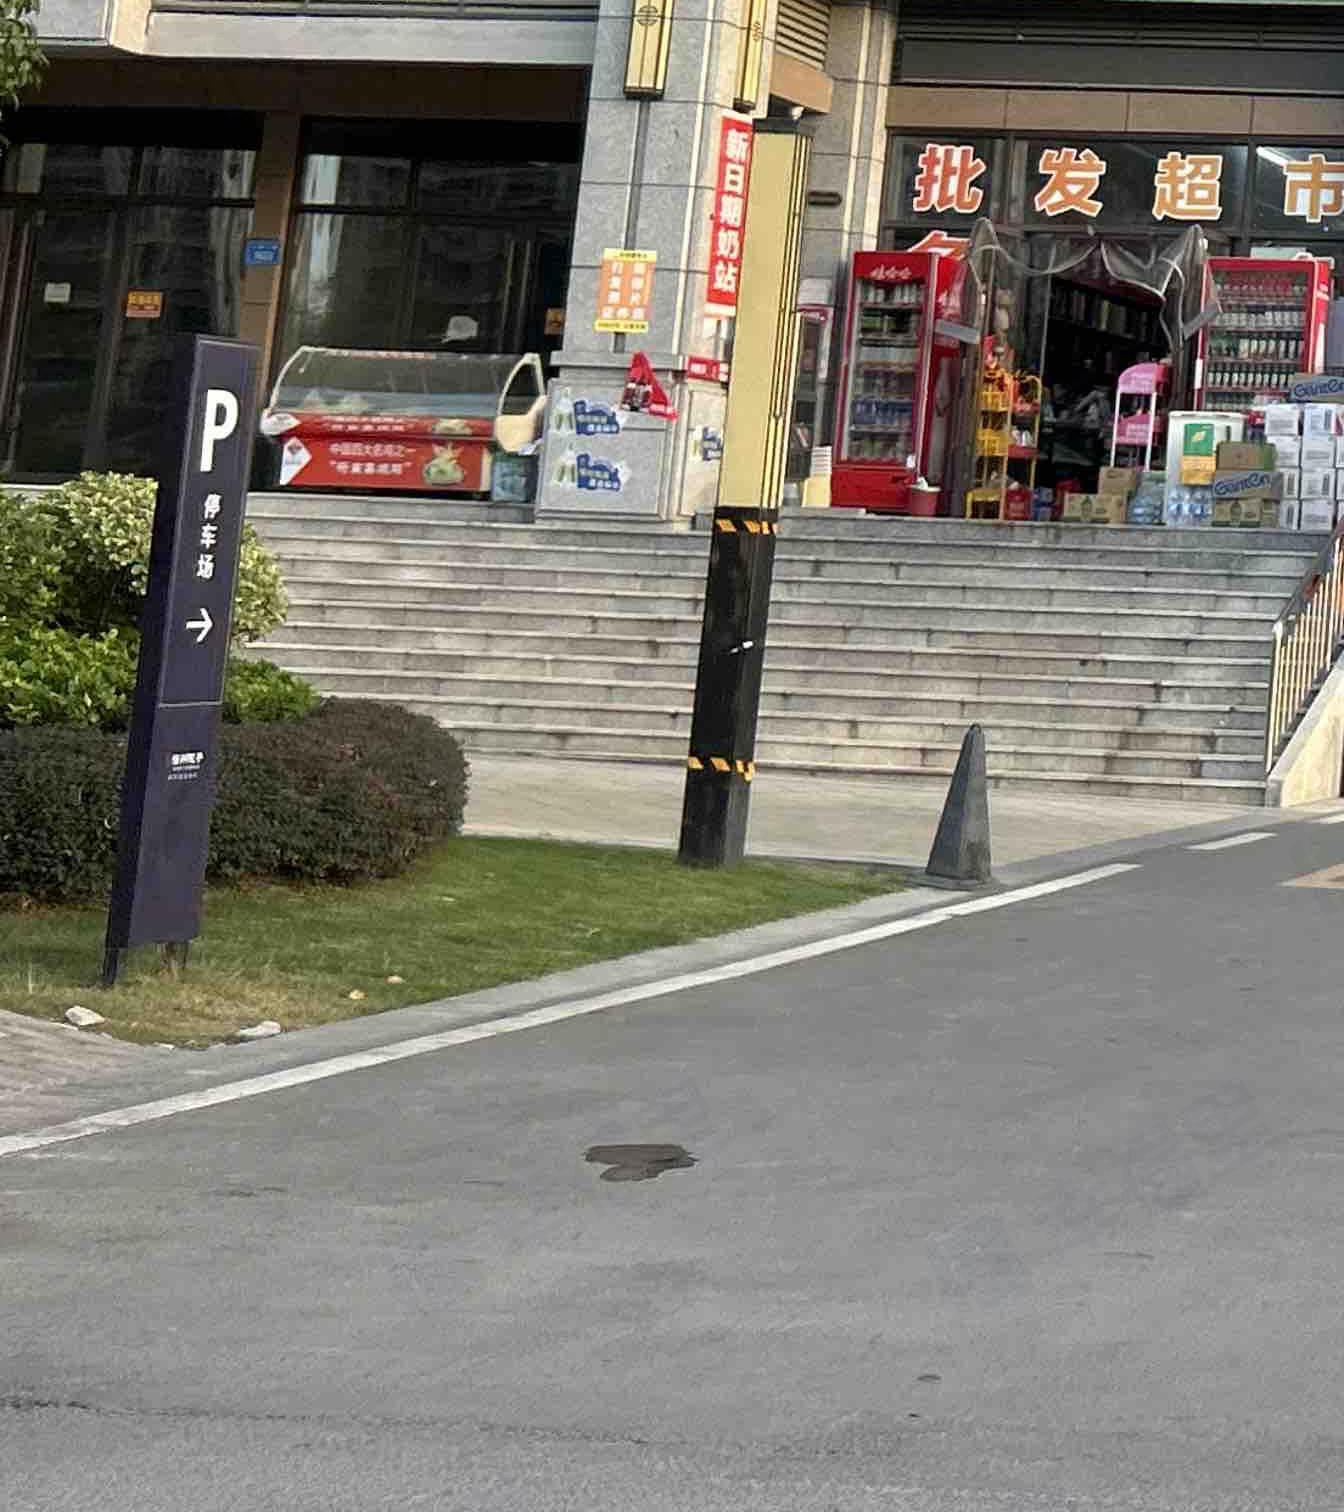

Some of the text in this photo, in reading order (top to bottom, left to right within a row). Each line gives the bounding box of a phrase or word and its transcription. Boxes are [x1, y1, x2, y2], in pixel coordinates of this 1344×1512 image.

[703, 128, 749, 292] 新日期奶站
[200, 389, 239, 472] P
[196, 492, 222, 579] 停车场
